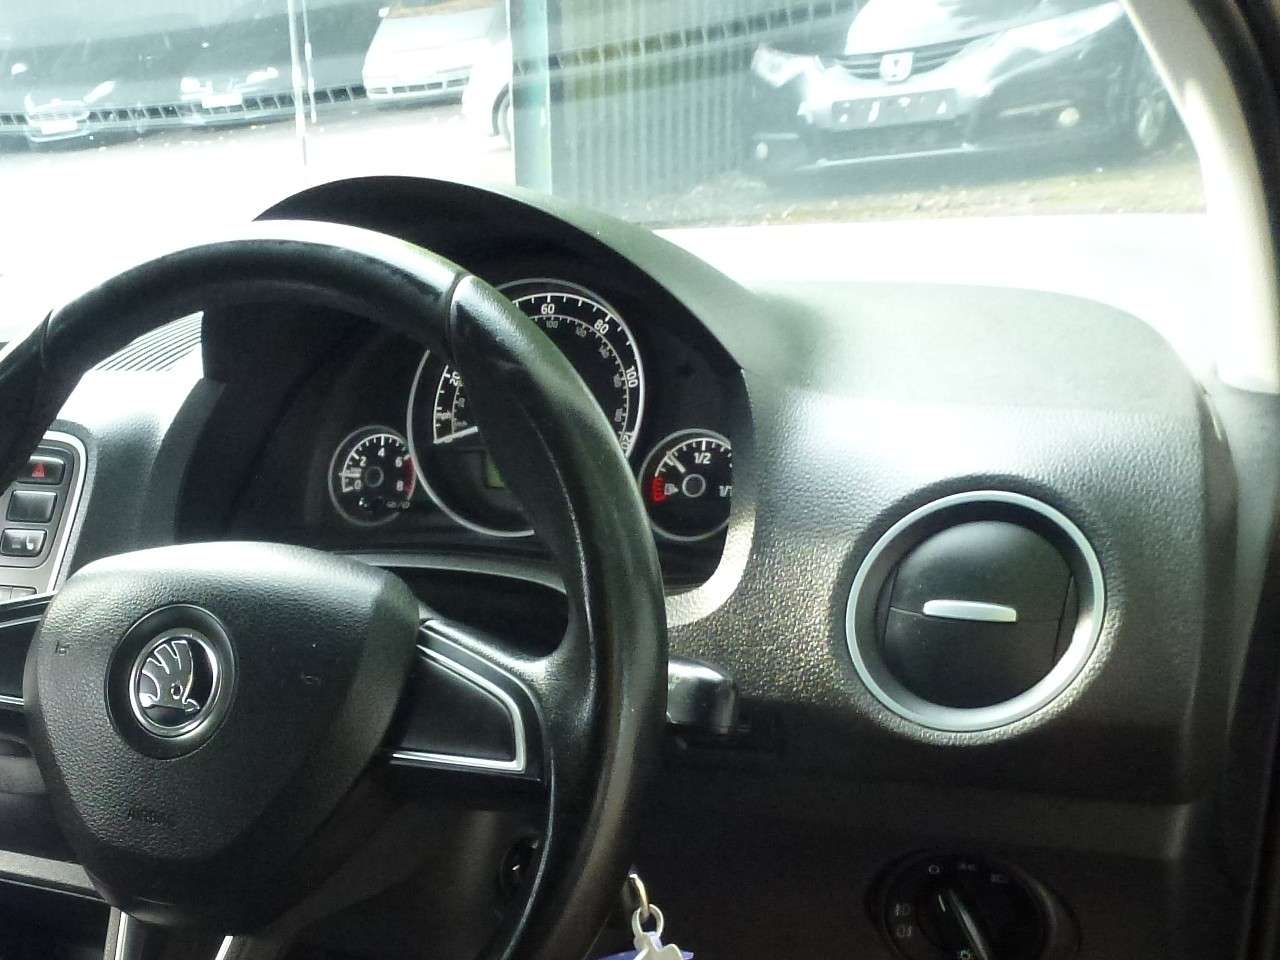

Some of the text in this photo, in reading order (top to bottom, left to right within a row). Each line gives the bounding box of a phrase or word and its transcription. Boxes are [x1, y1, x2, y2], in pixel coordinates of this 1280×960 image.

[541, 304, 555, 314] 60
[594, 319, 609, 334] 80
[450, 371, 461, 387] 20
[626, 365, 638, 388] 100
[377, 447, 385, 457] 4
[359, 456, 367, 467] 2
[395, 456, 403, 467] 6
[693, 452, 712, 464] 1/2
[396, 480, 404, 491] 8
